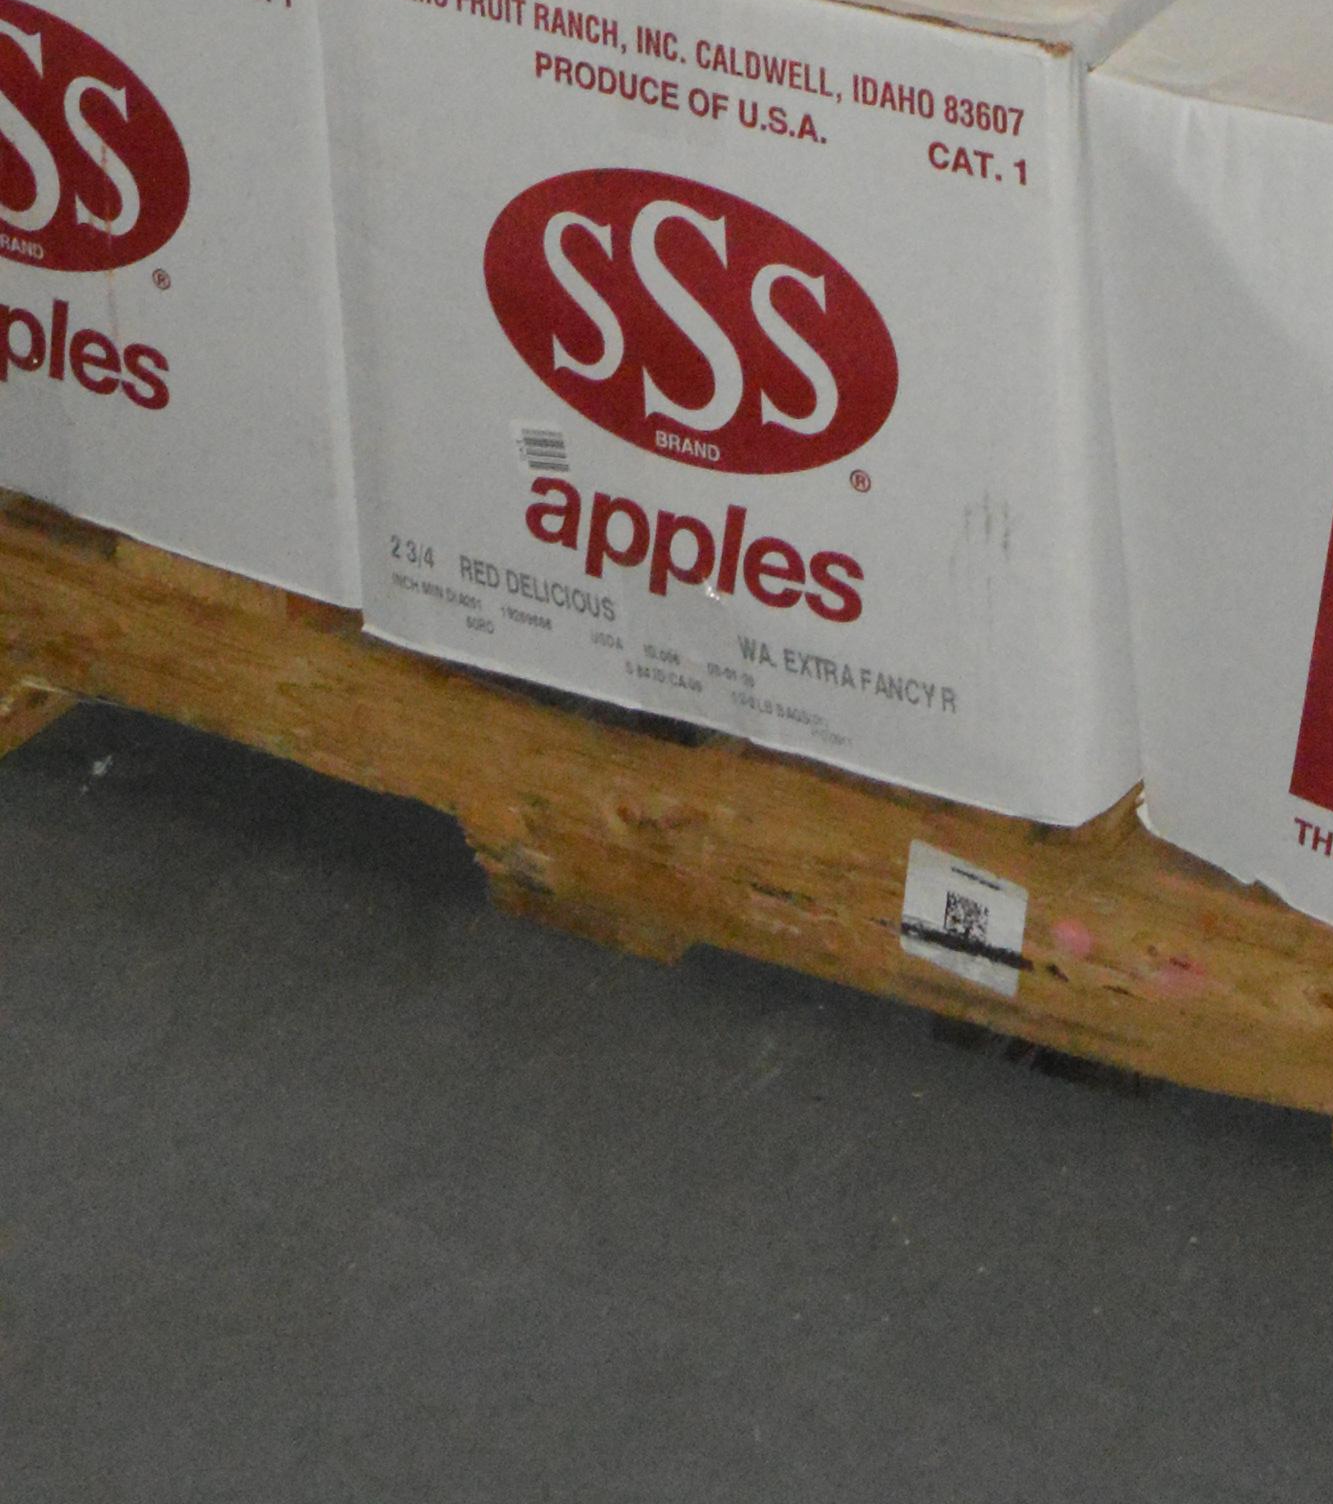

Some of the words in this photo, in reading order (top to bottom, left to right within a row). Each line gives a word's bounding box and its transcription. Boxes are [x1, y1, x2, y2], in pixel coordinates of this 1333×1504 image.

[533, 2, 627, 53] RANCH,
[636, 26, 686, 64] INC.
[695, 39, 842, 102] CALDWELL,
[852, 74, 935, 119] IDAHO
[943, 94, 1024, 136] 83607
[534, 50, 680, 111] PRODUCE
[687, 87, 729, 120] OF
[737, 98, 827, 144] U.S.A.
[927, 140, 1002, 183] CAT.
[1013, 159, 1027, 185] 1
[0, 299, 170, 411] ples
[542, 199, 840, 441] SSS
[655, 431, 720, 462] BRAND
[460, 555, 500, 589] RED
[506, 570, 617, 622] DELICIOUS
[525, 476, 865, 624] apples
